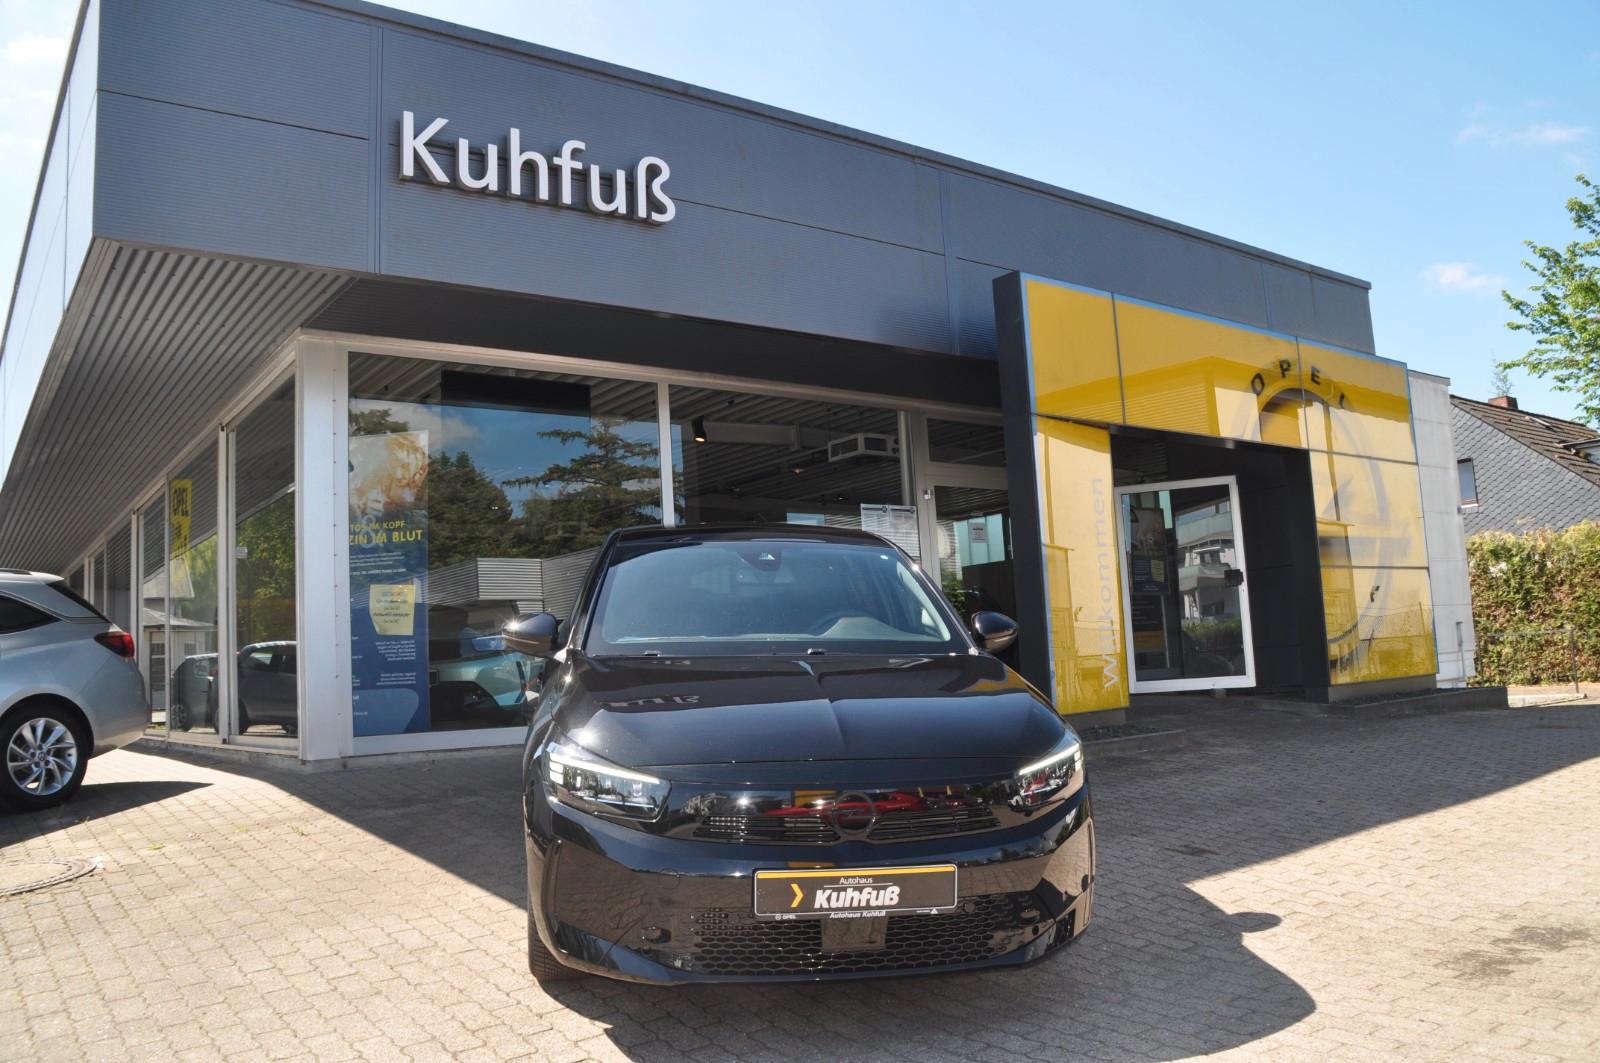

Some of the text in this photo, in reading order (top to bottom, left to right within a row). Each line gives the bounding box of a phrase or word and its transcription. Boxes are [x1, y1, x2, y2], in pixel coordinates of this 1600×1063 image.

[400, 110, 676, 223] Kuhfuß
[392, 529, 423, 542] BLUT
[839, 877, 873, 885] Autohaus
[814, 885, 900, 909] Kuhfuß
[829, 911, 861, 919] Autohaus
